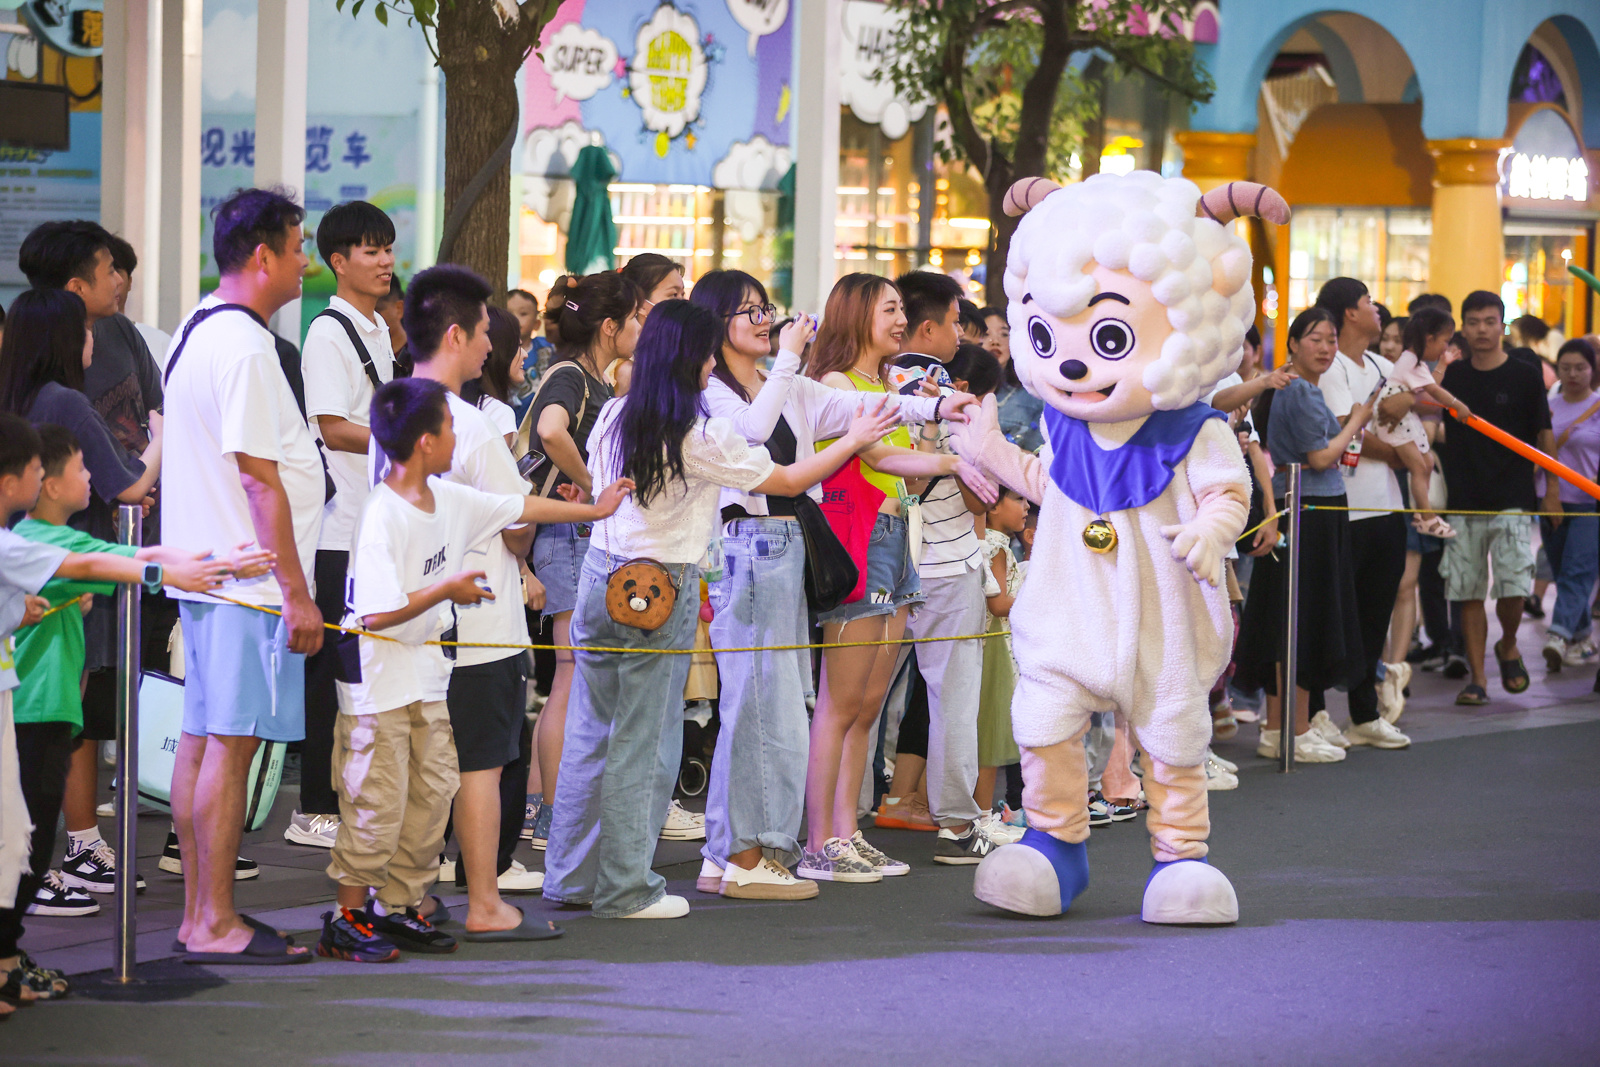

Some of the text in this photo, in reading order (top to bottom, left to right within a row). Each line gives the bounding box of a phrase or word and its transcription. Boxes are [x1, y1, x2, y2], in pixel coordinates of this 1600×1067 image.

[553, 45, 606, 75] SUPER
[201, 126, 371, 172] 观光览车
